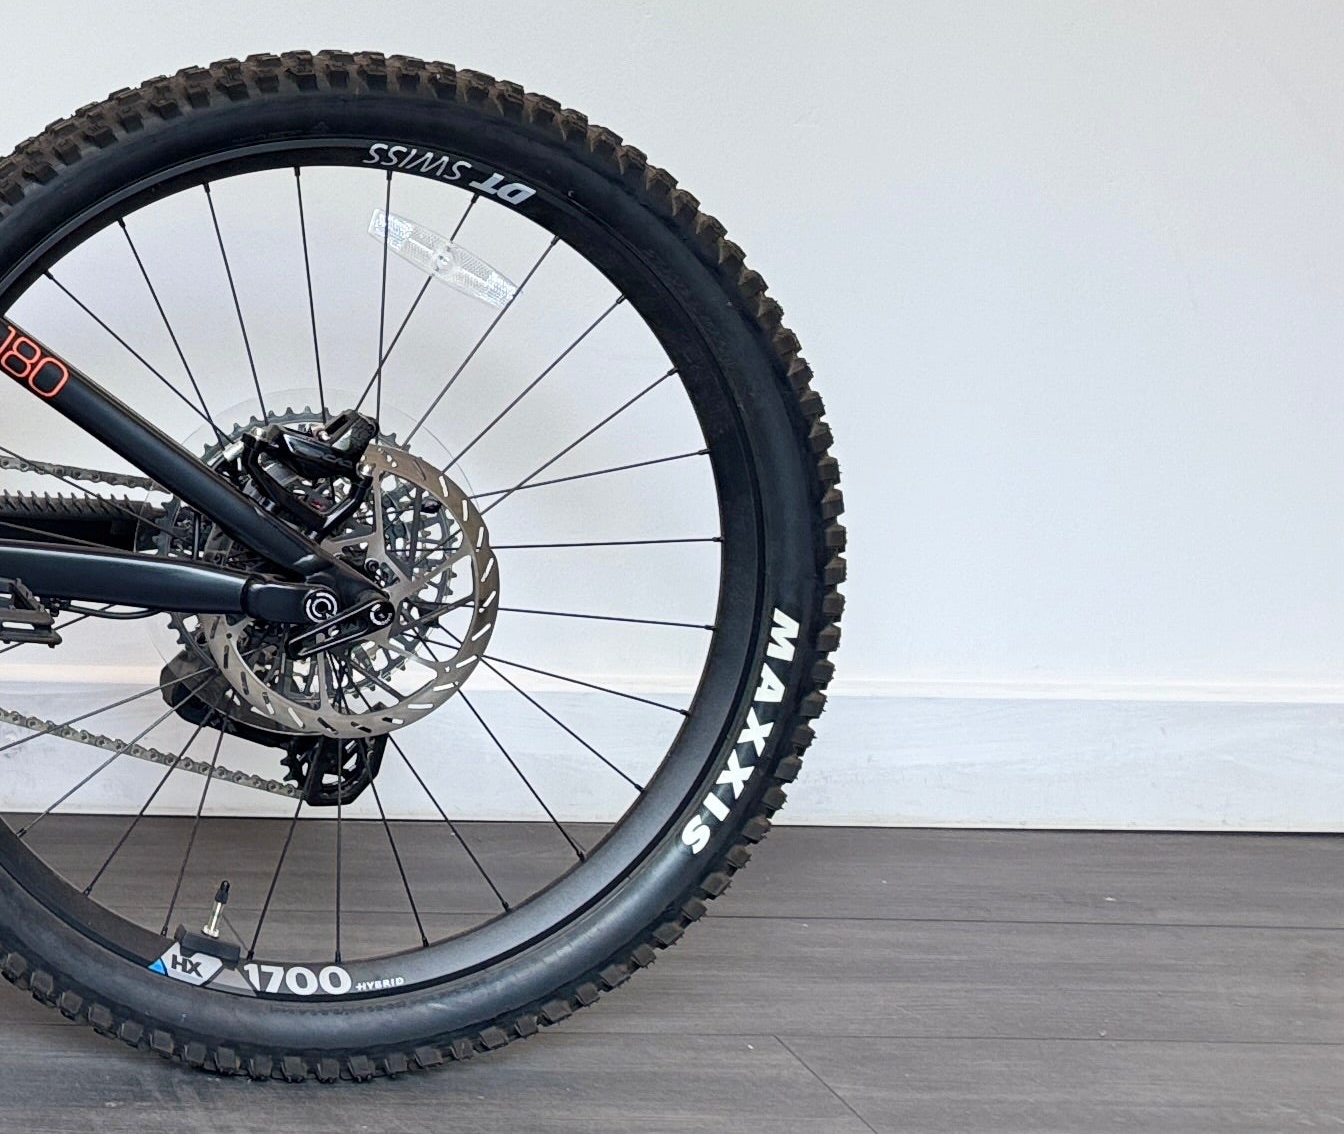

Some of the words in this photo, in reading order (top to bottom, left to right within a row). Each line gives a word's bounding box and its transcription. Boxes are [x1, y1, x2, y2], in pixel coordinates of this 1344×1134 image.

[362, 143, 472, 180] SWISS
[469, 173, 537, 205] DT
[680, 607, 801, 855] MAXXIS
[171, 954, 204, 978] HX
[244, 964, 352, 995] 1700
